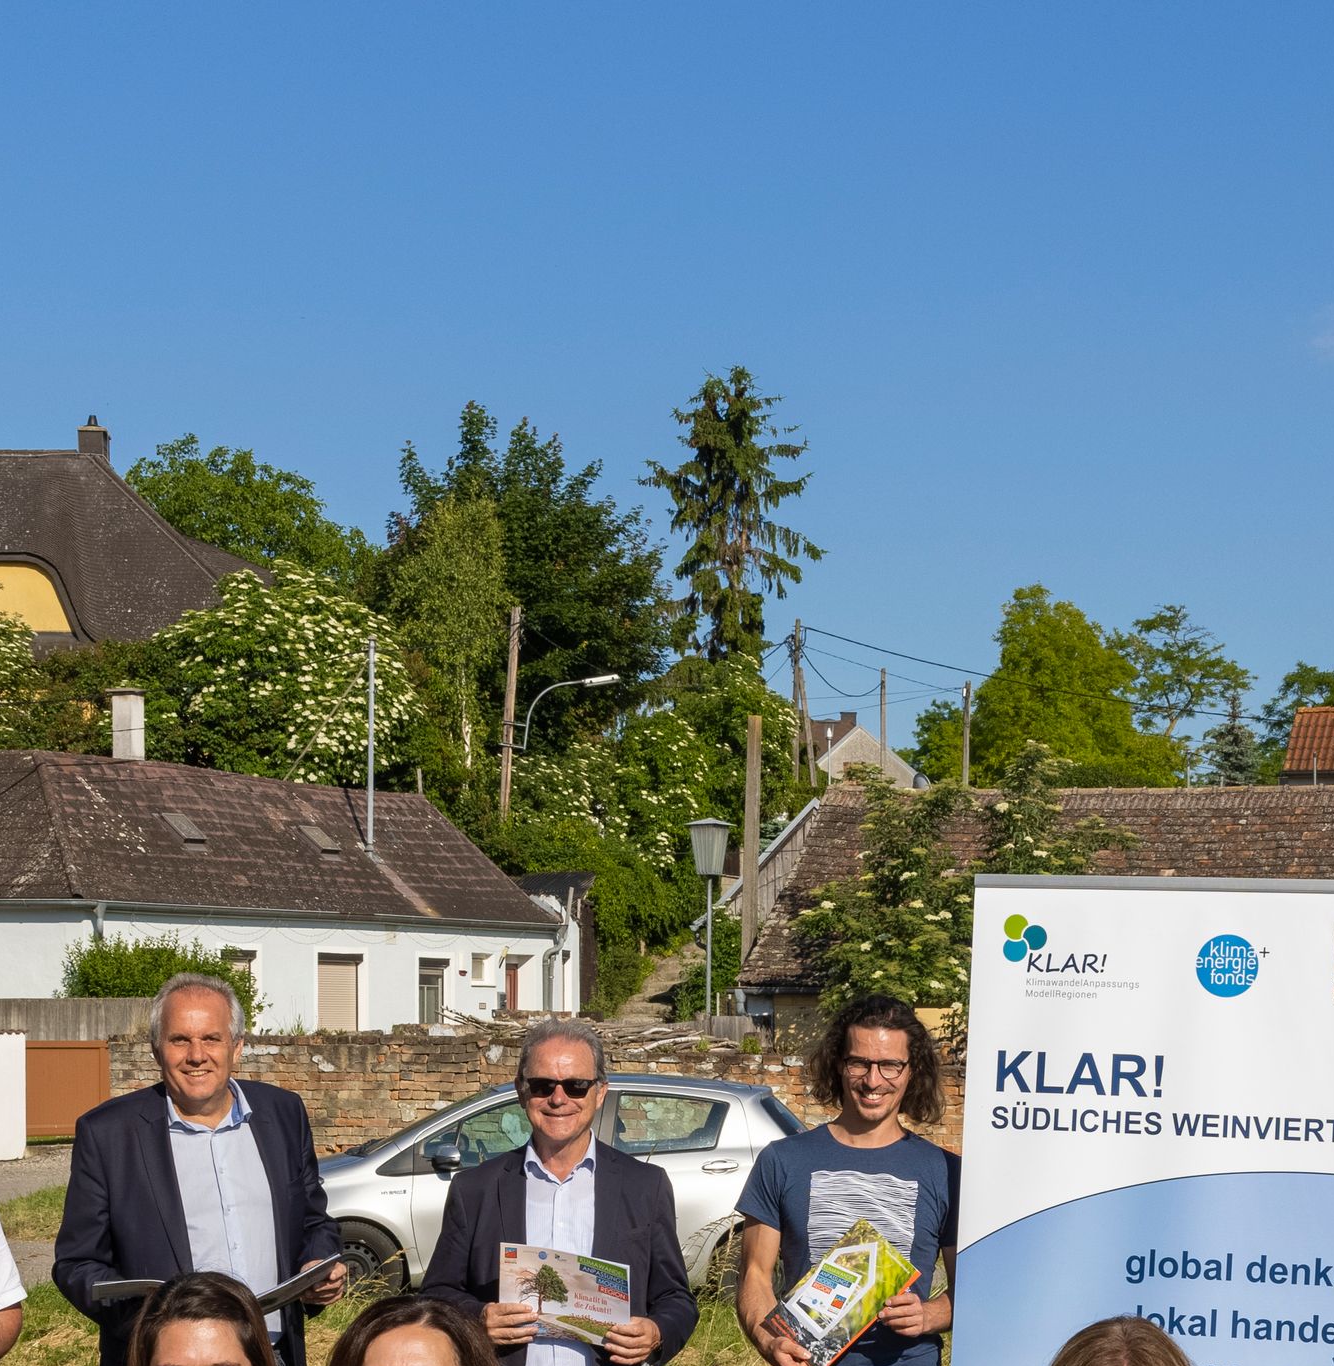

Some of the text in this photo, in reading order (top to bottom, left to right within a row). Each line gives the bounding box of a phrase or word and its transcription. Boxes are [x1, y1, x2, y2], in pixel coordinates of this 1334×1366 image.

[1210, 941, 1256, 958] klima
[1027, 953, 1107, 973] KLAR!
[1195, 957, 1256, 973] energie
[1026, 978, 1139, 990] KlimawandelAnpassungs
[1210, 969, 1255, 985] fonds
[1025, 990, 1097, 1000] ModellRegionen
[995, 1050, 1164, 1098] KLAR!
[991, 1101, 1163, 1136] SÜDLICHES
[1126, 1249, 1233, 1284] global
[600, 1287, 626, 1299] REGION
[585, 1302, 611, 1315] Zukunft!
